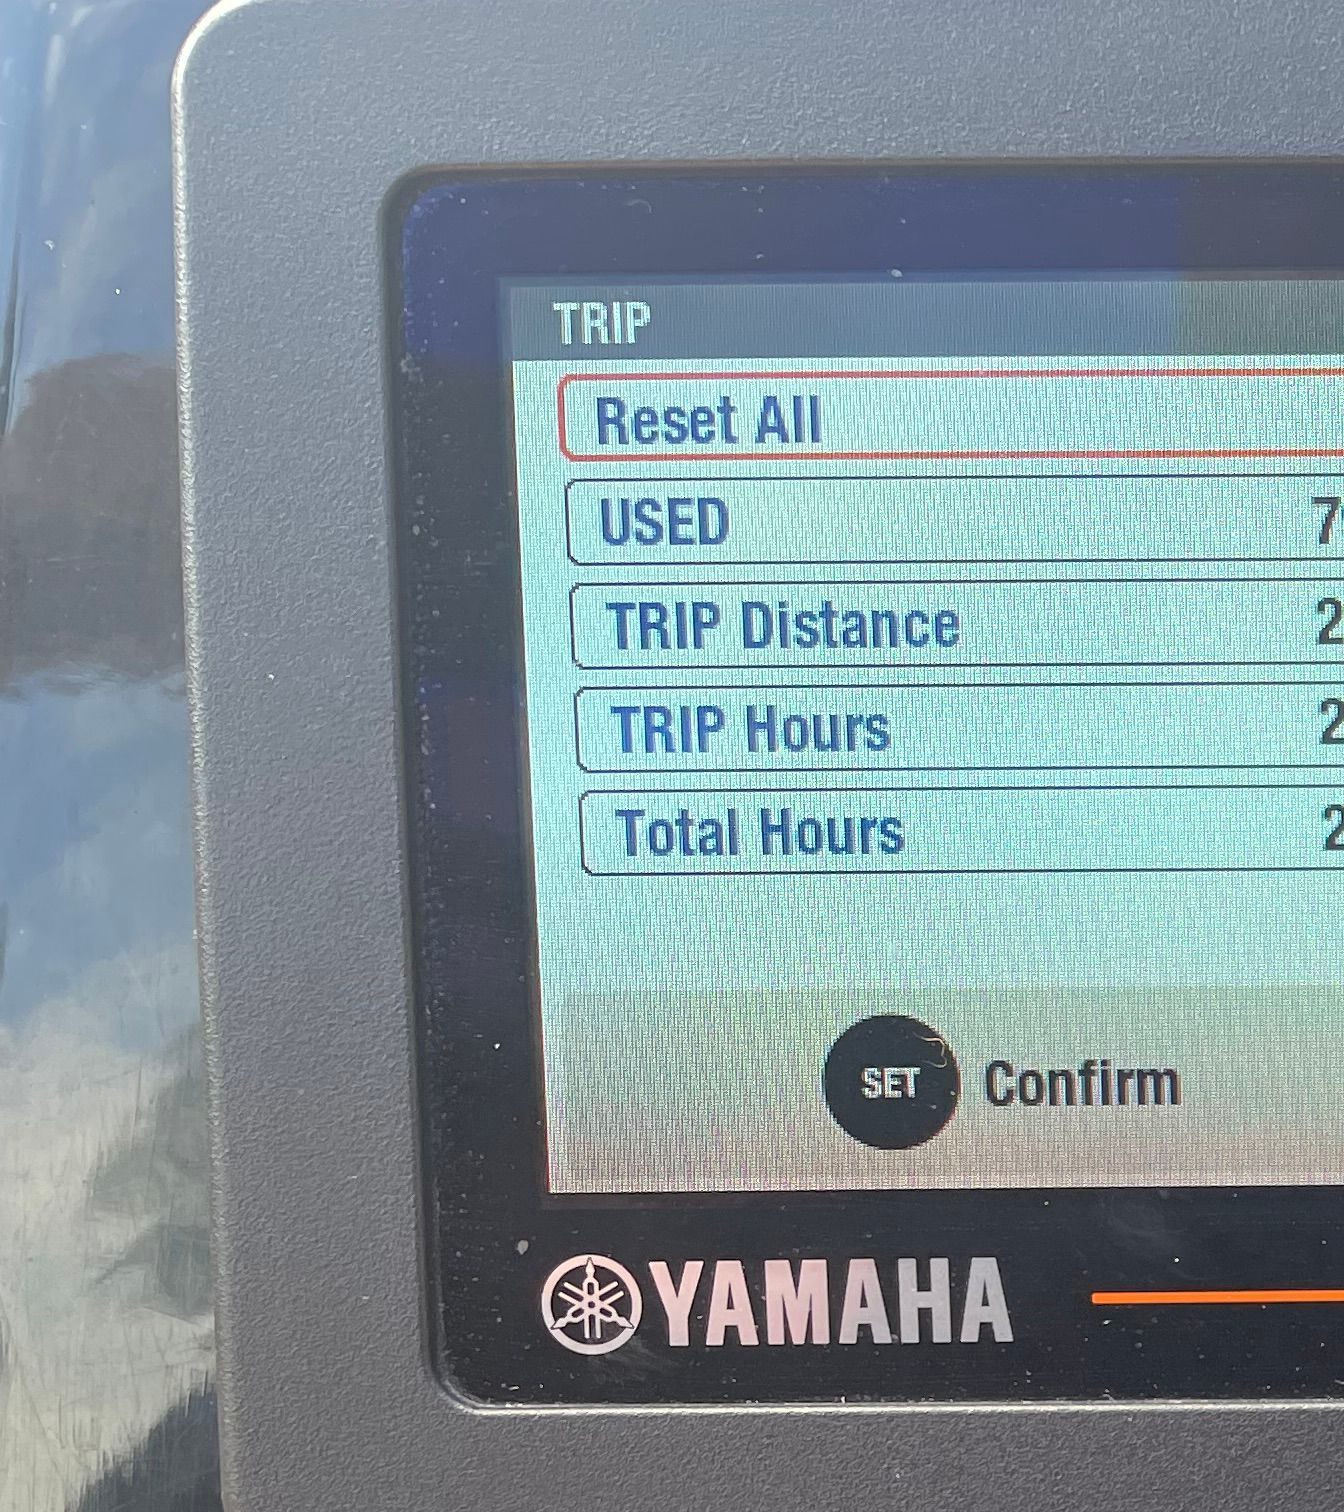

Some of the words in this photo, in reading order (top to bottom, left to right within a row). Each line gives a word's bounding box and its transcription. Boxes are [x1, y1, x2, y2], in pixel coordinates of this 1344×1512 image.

[553, 301, 652, 346] TRIP
[597, 396, 738, 445] Reset
[755, 396, 823, 444] All
[600, 497, 731, 547] USED
[606, 602, 720, 651] TRIP
[742, 601, 960, 650] Distance
[610, 705, 726, 754] TRIP
[746, 704, 891, 753] Hours
[615, 808, 738, 856] Total
[759, 807, 904, 856] Hours
[860, 1066, 921, 1099] SET
[985, 1059, 1182, 1107] Confirm
[648, 1257, 1014, 1348] YAMAHA
